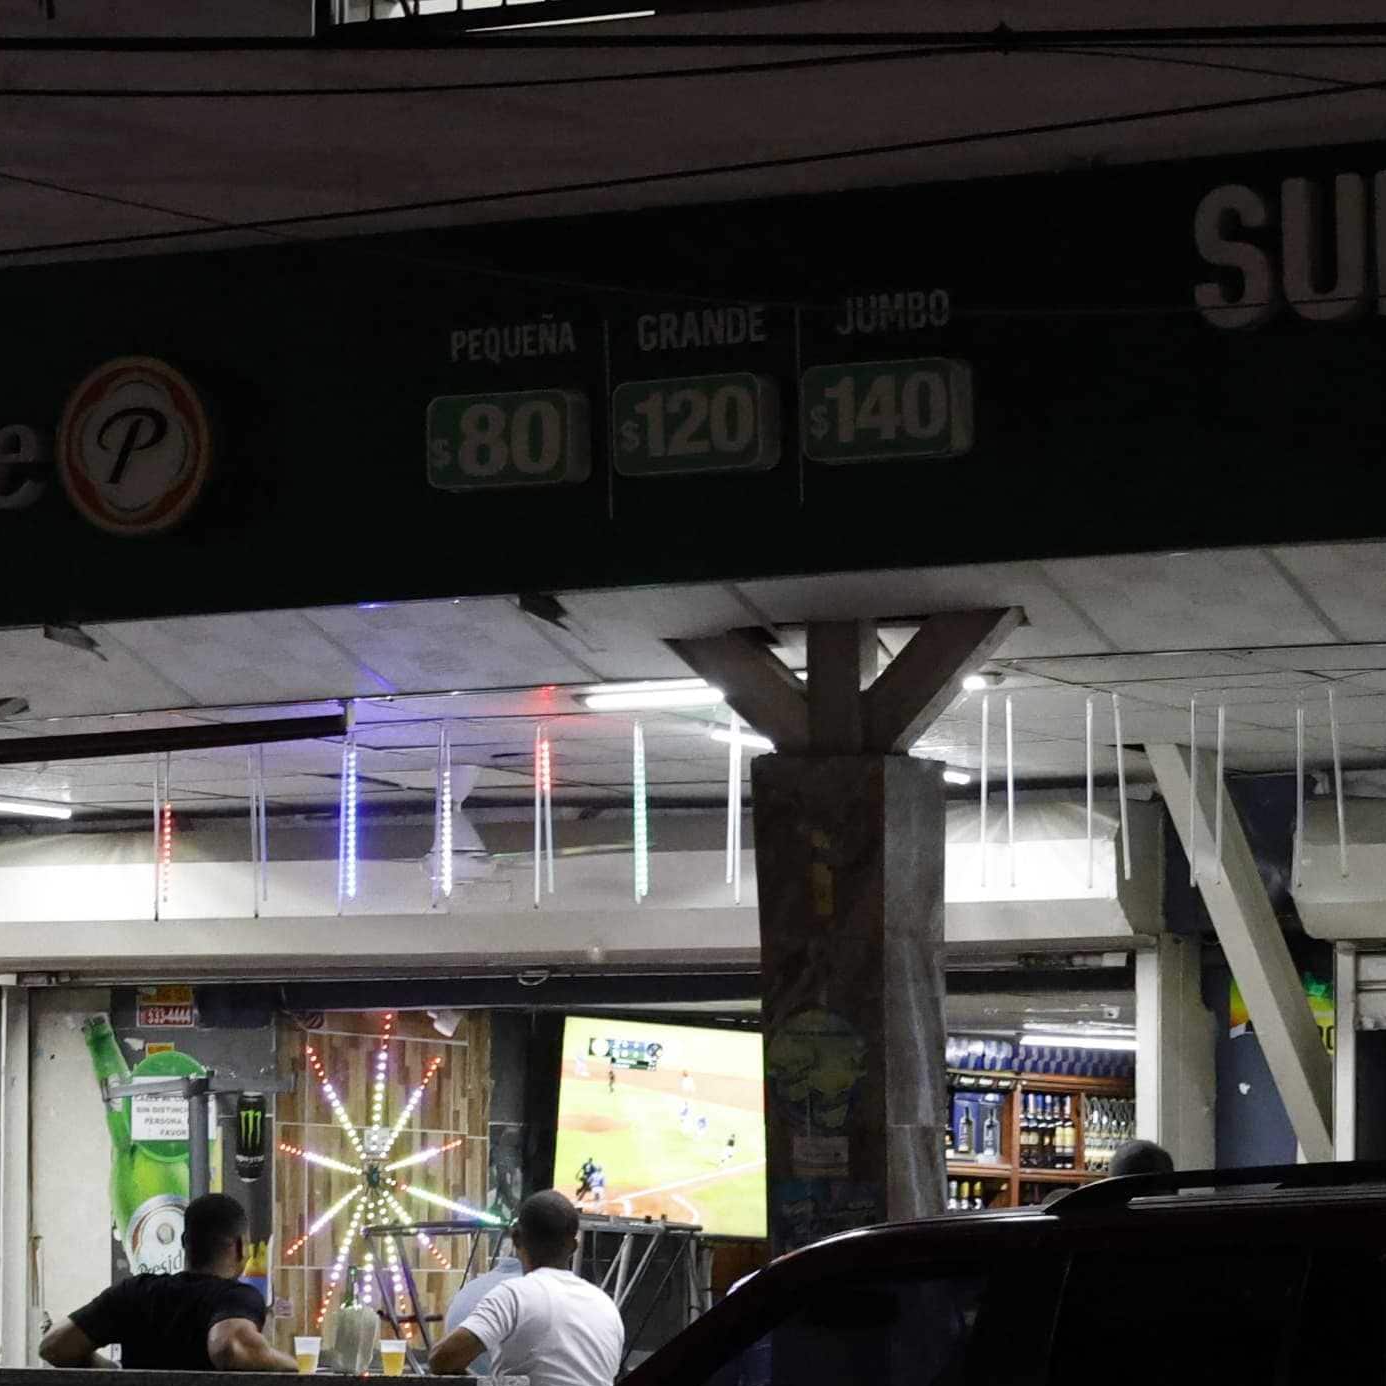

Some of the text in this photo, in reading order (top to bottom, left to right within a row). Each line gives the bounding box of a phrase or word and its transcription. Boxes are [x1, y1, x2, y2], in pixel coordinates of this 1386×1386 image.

[449, 313, 576, 362] PEQUEÑA
[637, 306, 767, 352] GRANDE
[837, 289, 951, 335] JUMBO
[620, 385, 757, 460] $120
[809, 371, 949, 447] $140
[429, 402, 564, 481] $80
